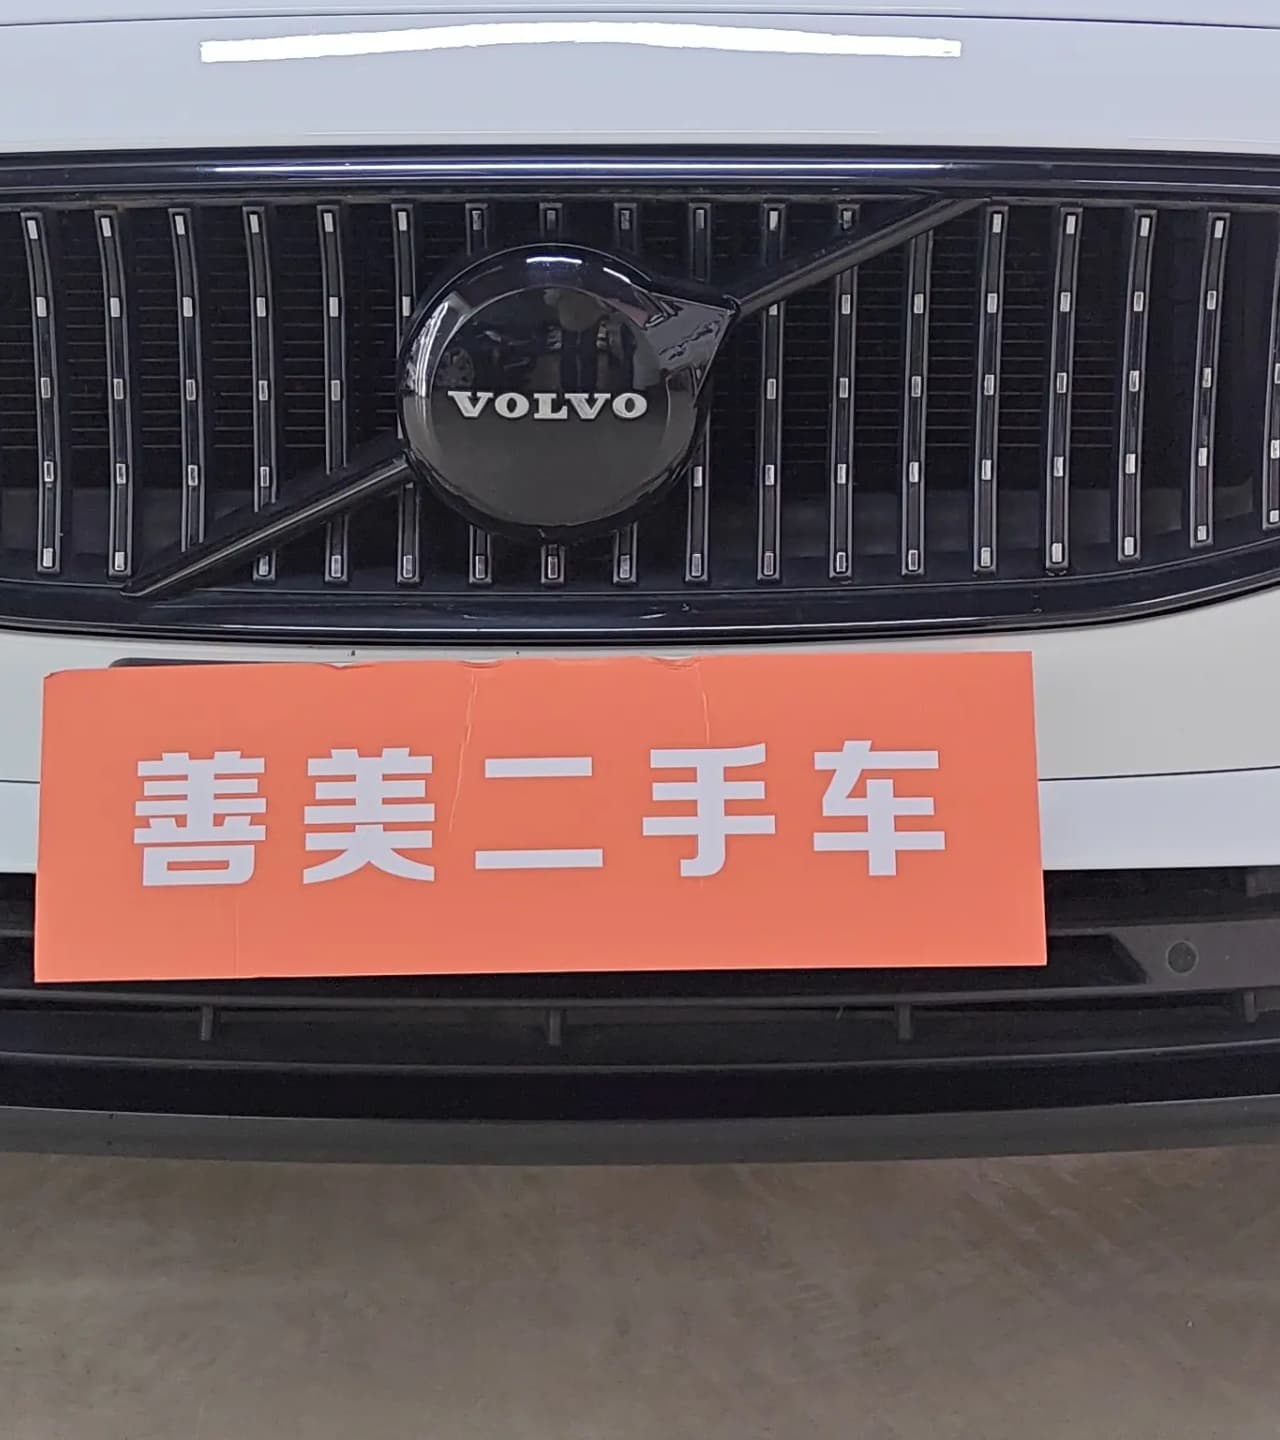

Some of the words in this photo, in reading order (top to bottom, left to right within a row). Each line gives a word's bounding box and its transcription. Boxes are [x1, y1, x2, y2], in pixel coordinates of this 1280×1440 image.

[447, 390, 648, 420] VOLVO
[133, 740, 946, 887] 善美二手车
